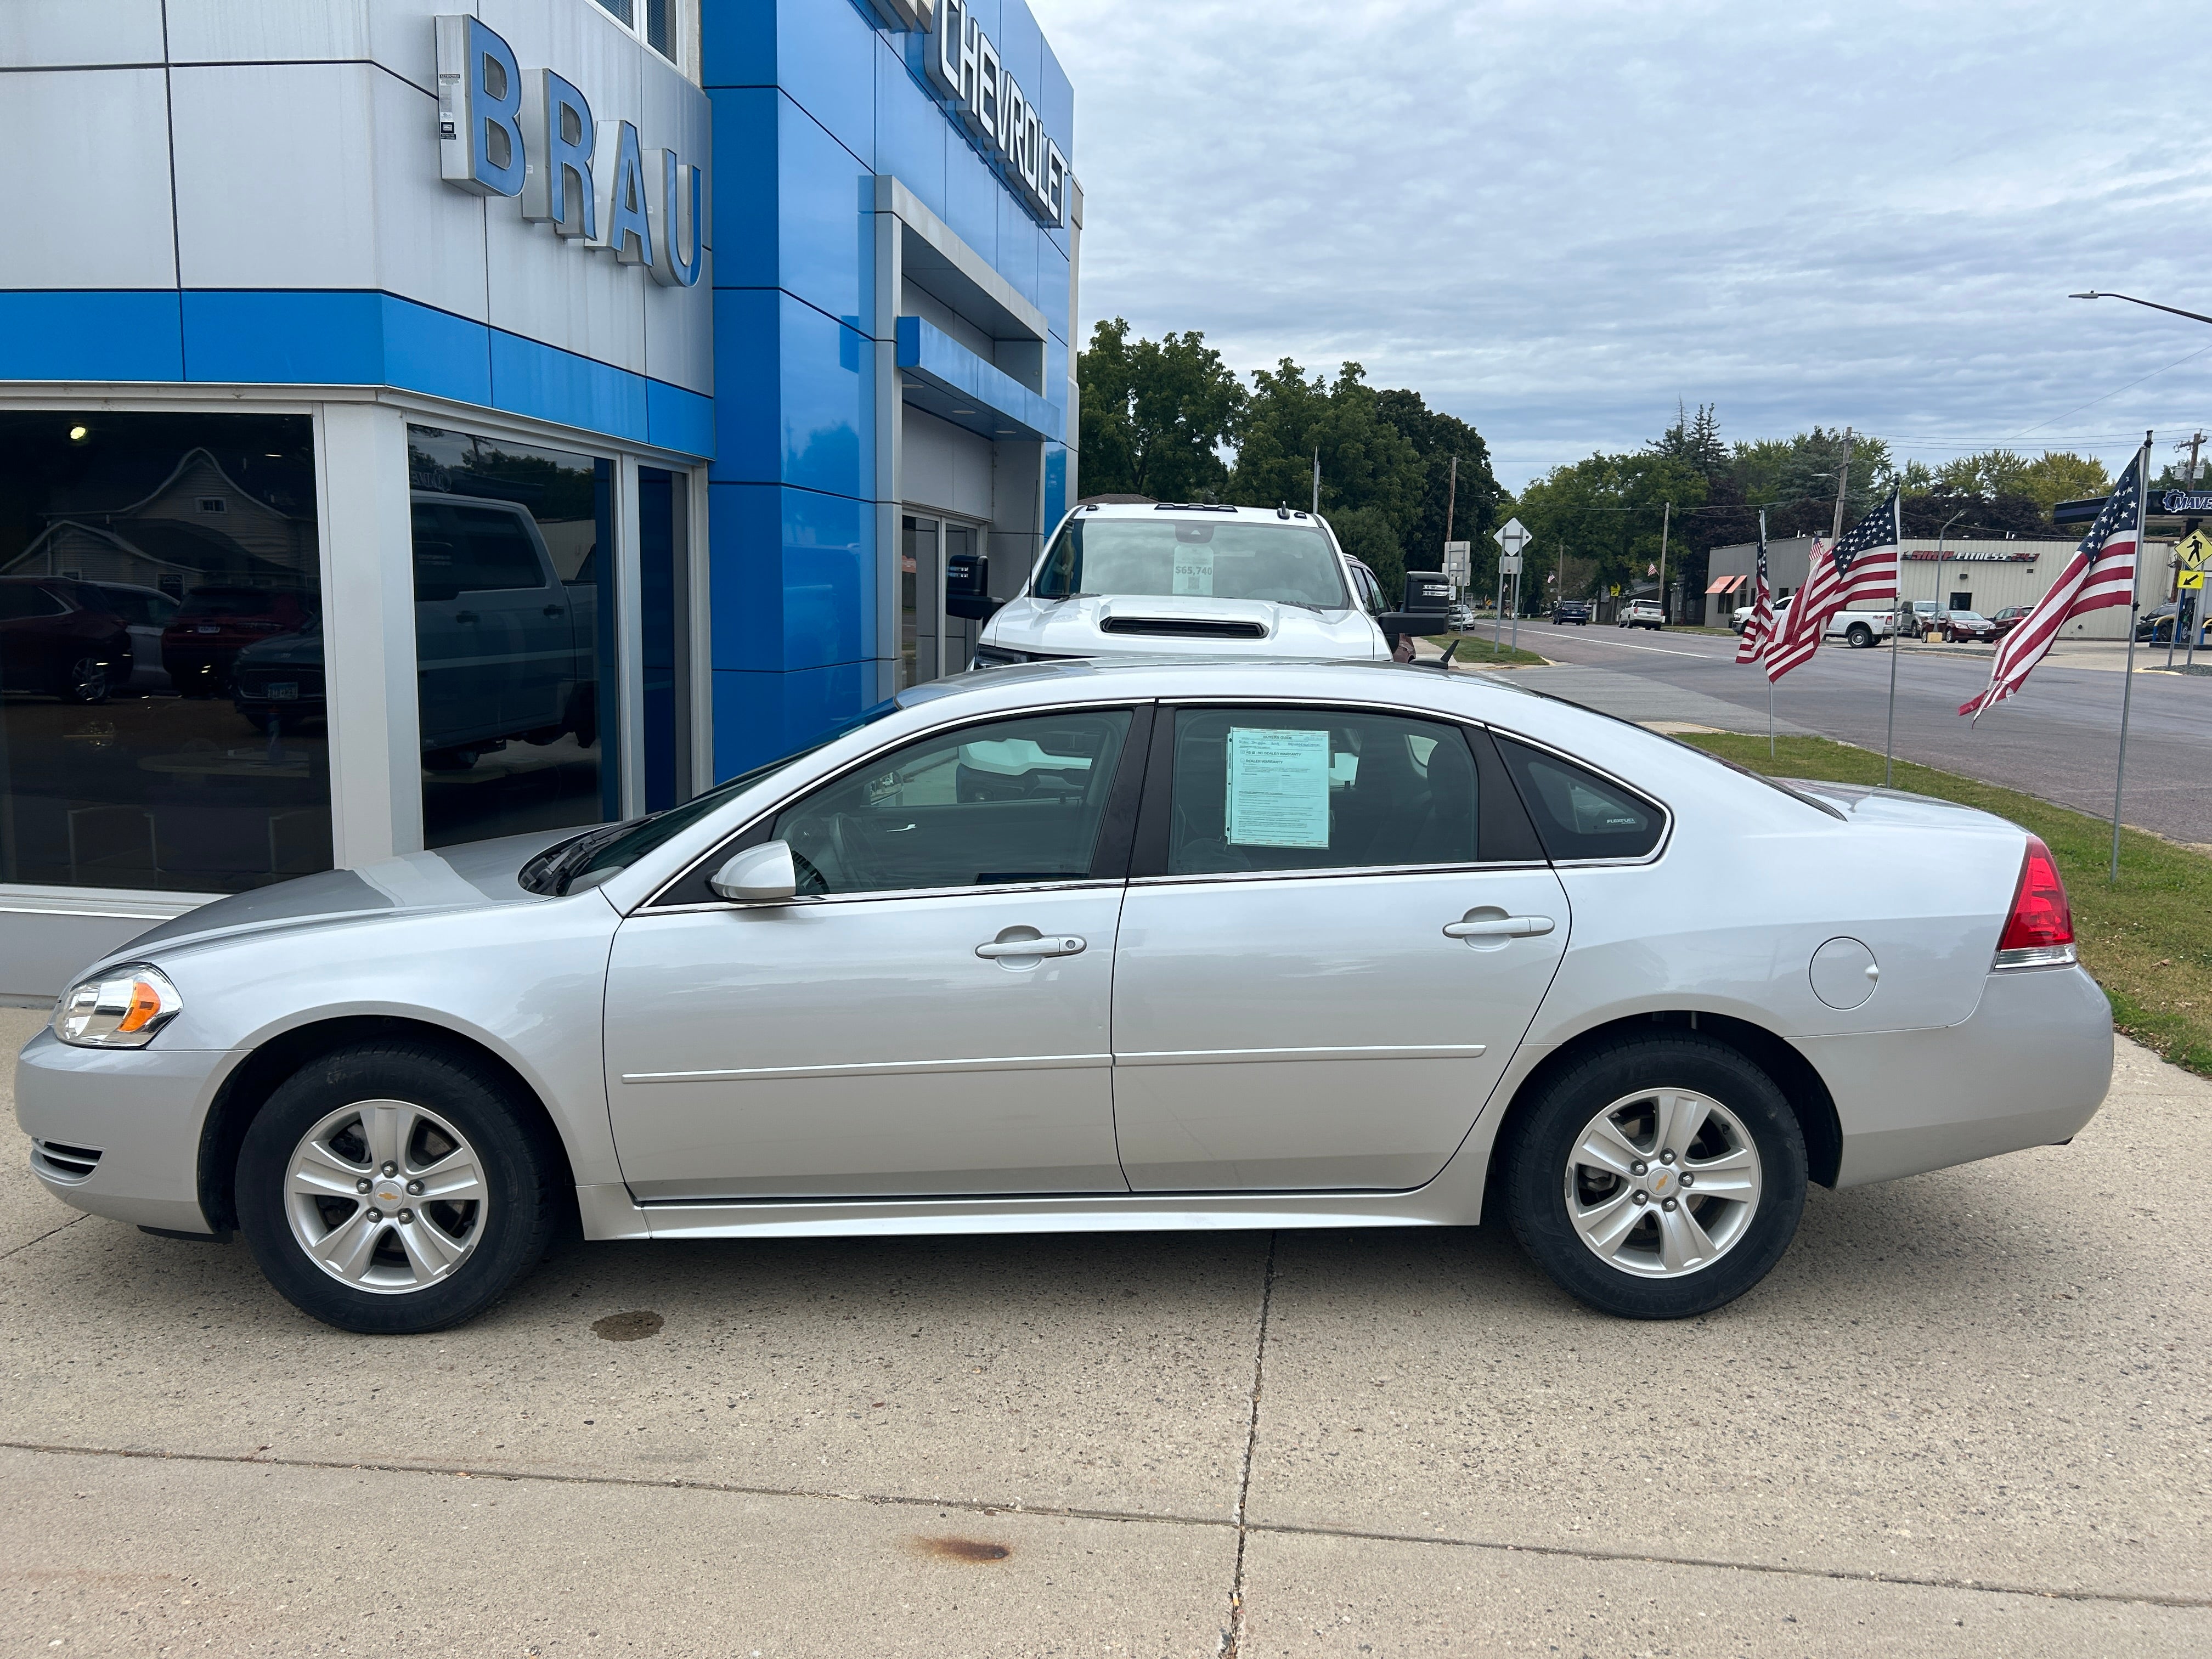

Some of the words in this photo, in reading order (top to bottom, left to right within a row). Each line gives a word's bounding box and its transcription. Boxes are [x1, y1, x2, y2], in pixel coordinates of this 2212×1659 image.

[467, 14, 702, 287] BRAU
[940, 0, 1070, 229] CHEVROLET
[1175, 566, 1212, 576] $65,740
[1956, 552, 2007, 560] FITNESS
